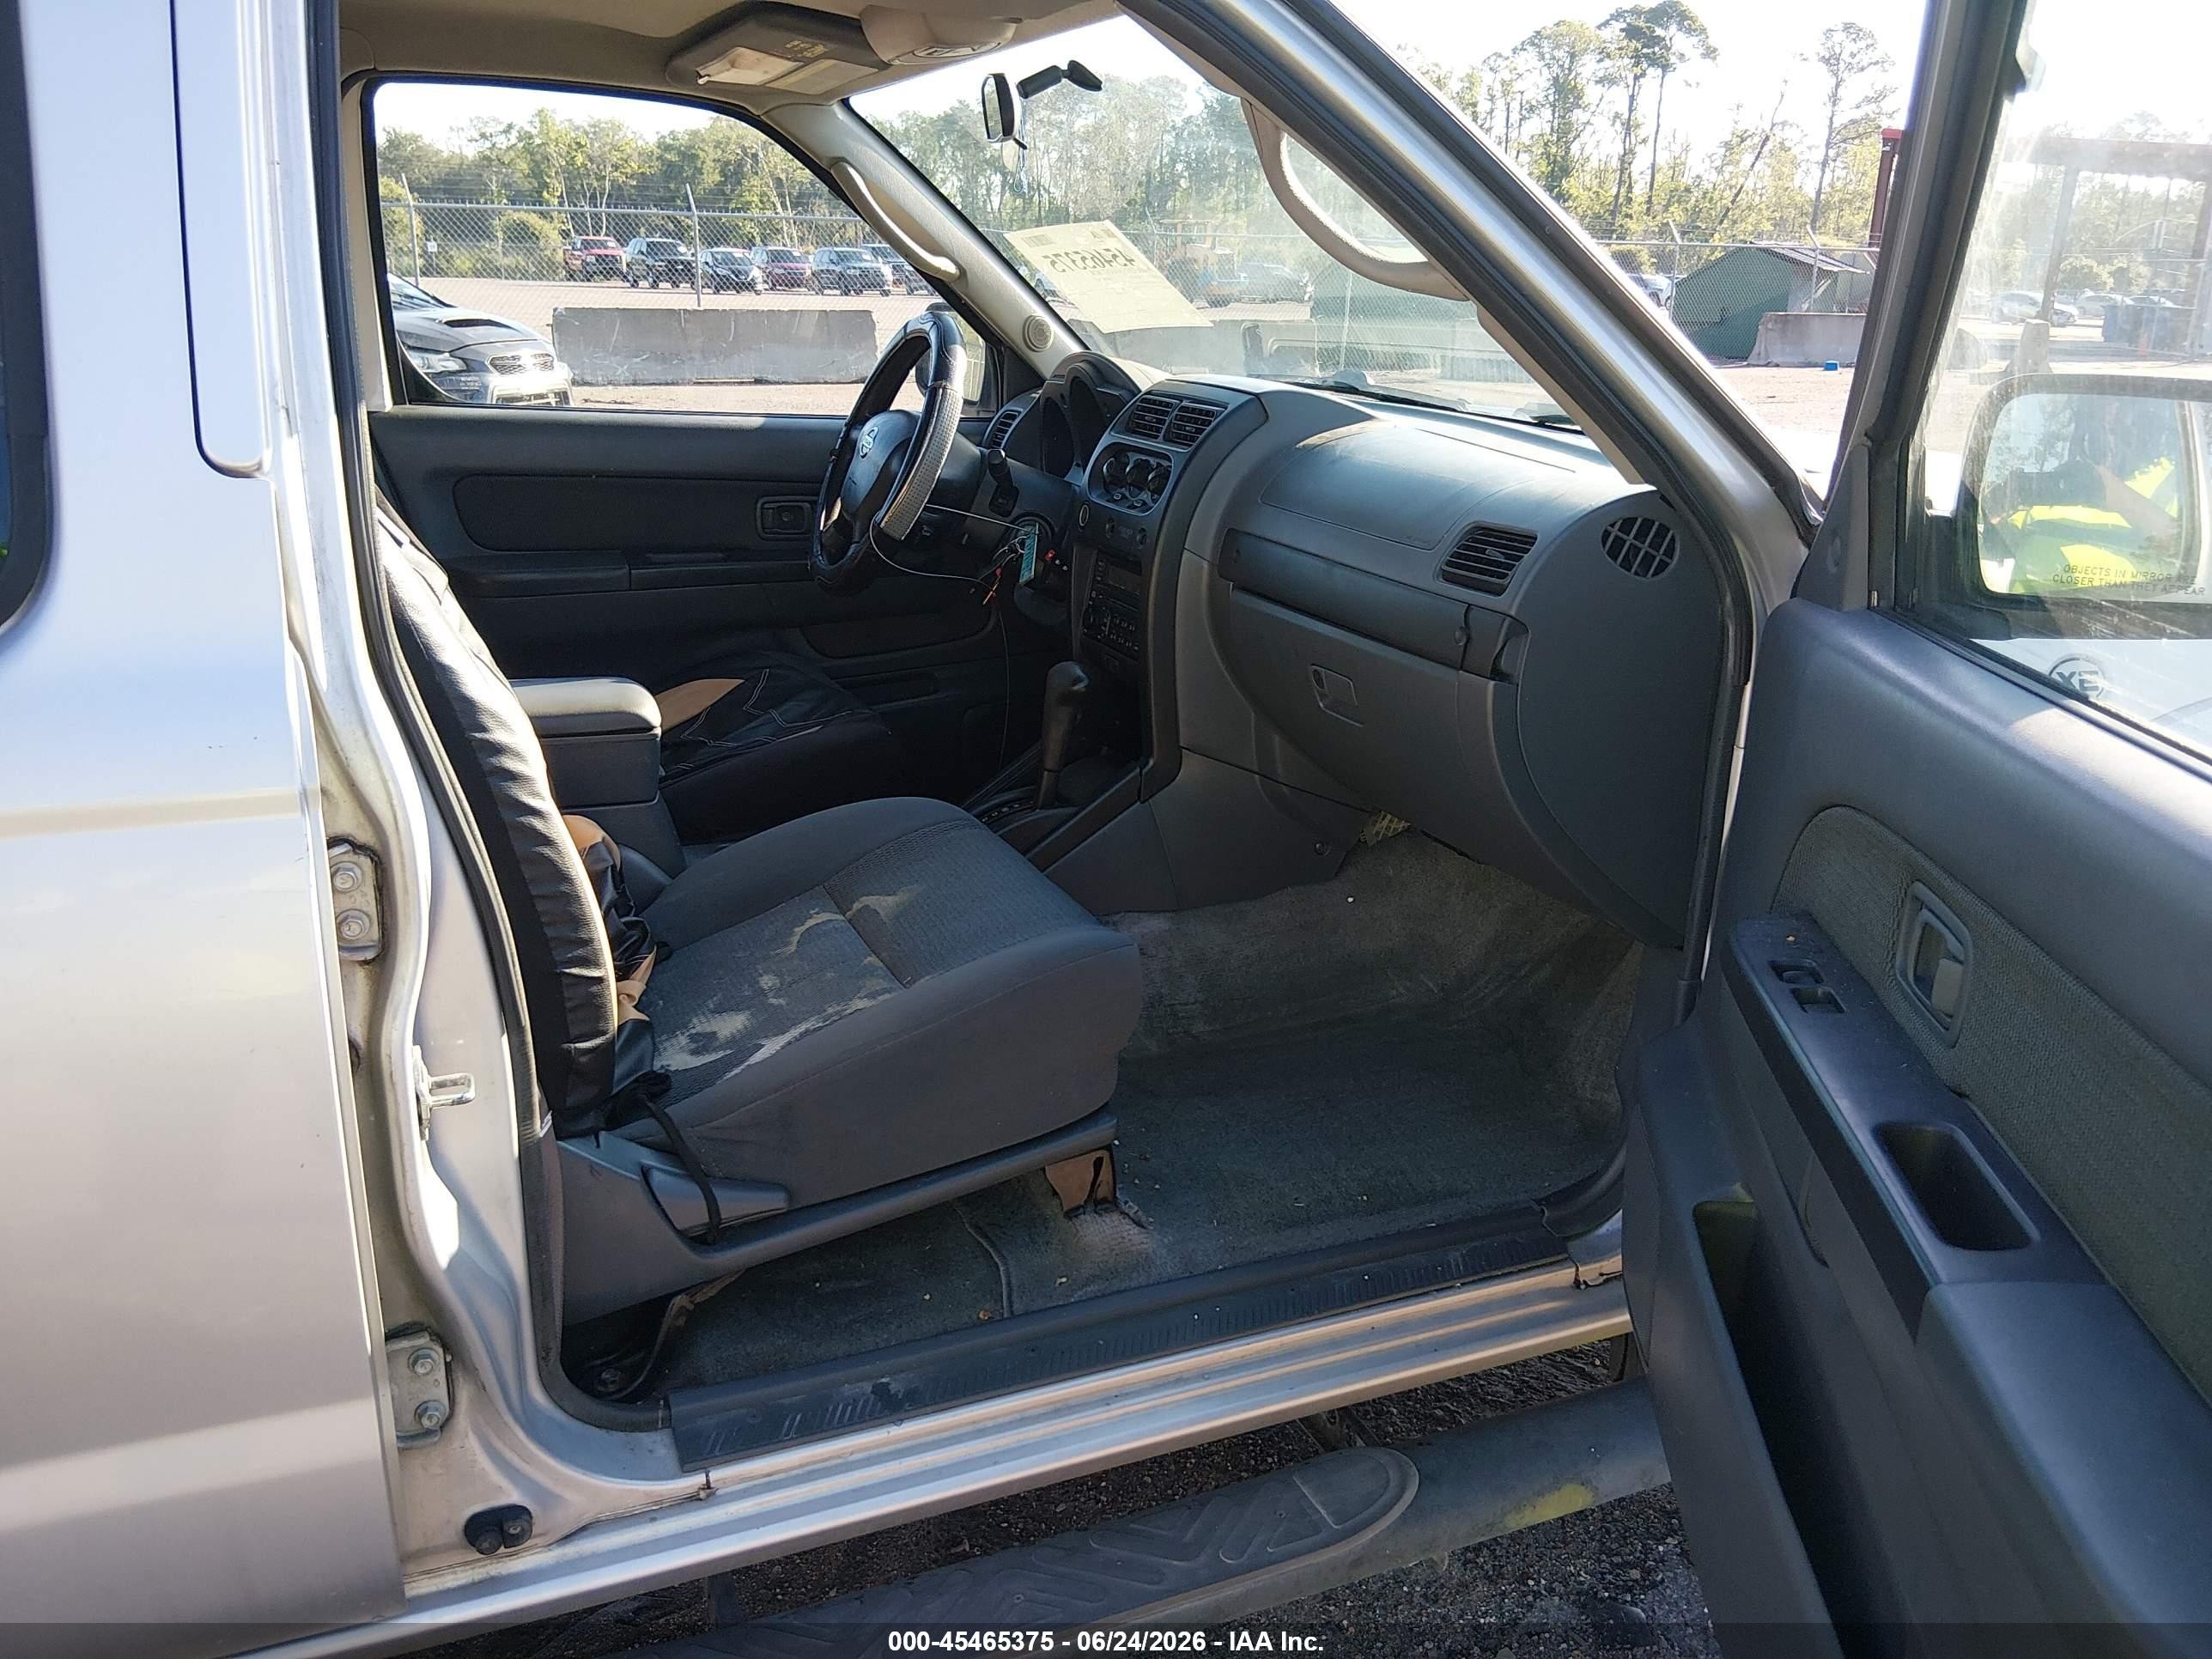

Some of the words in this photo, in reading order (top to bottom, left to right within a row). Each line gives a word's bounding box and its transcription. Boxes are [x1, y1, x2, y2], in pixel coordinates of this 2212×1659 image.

[2063, 563, 2111, 576] OBJECTS
[2115, 569, 2126, 578] IN
[2130, 570, 2172, 582] MIRROR
[2052, 574, 2094, 586] CLOSER
[2100, 578, 2127, 589] THAN
[2130, 580, 2157, 592] THEY
[2160, 583, 2206, 596] APPEAR
[2056, 670, 2100, 692] XE
